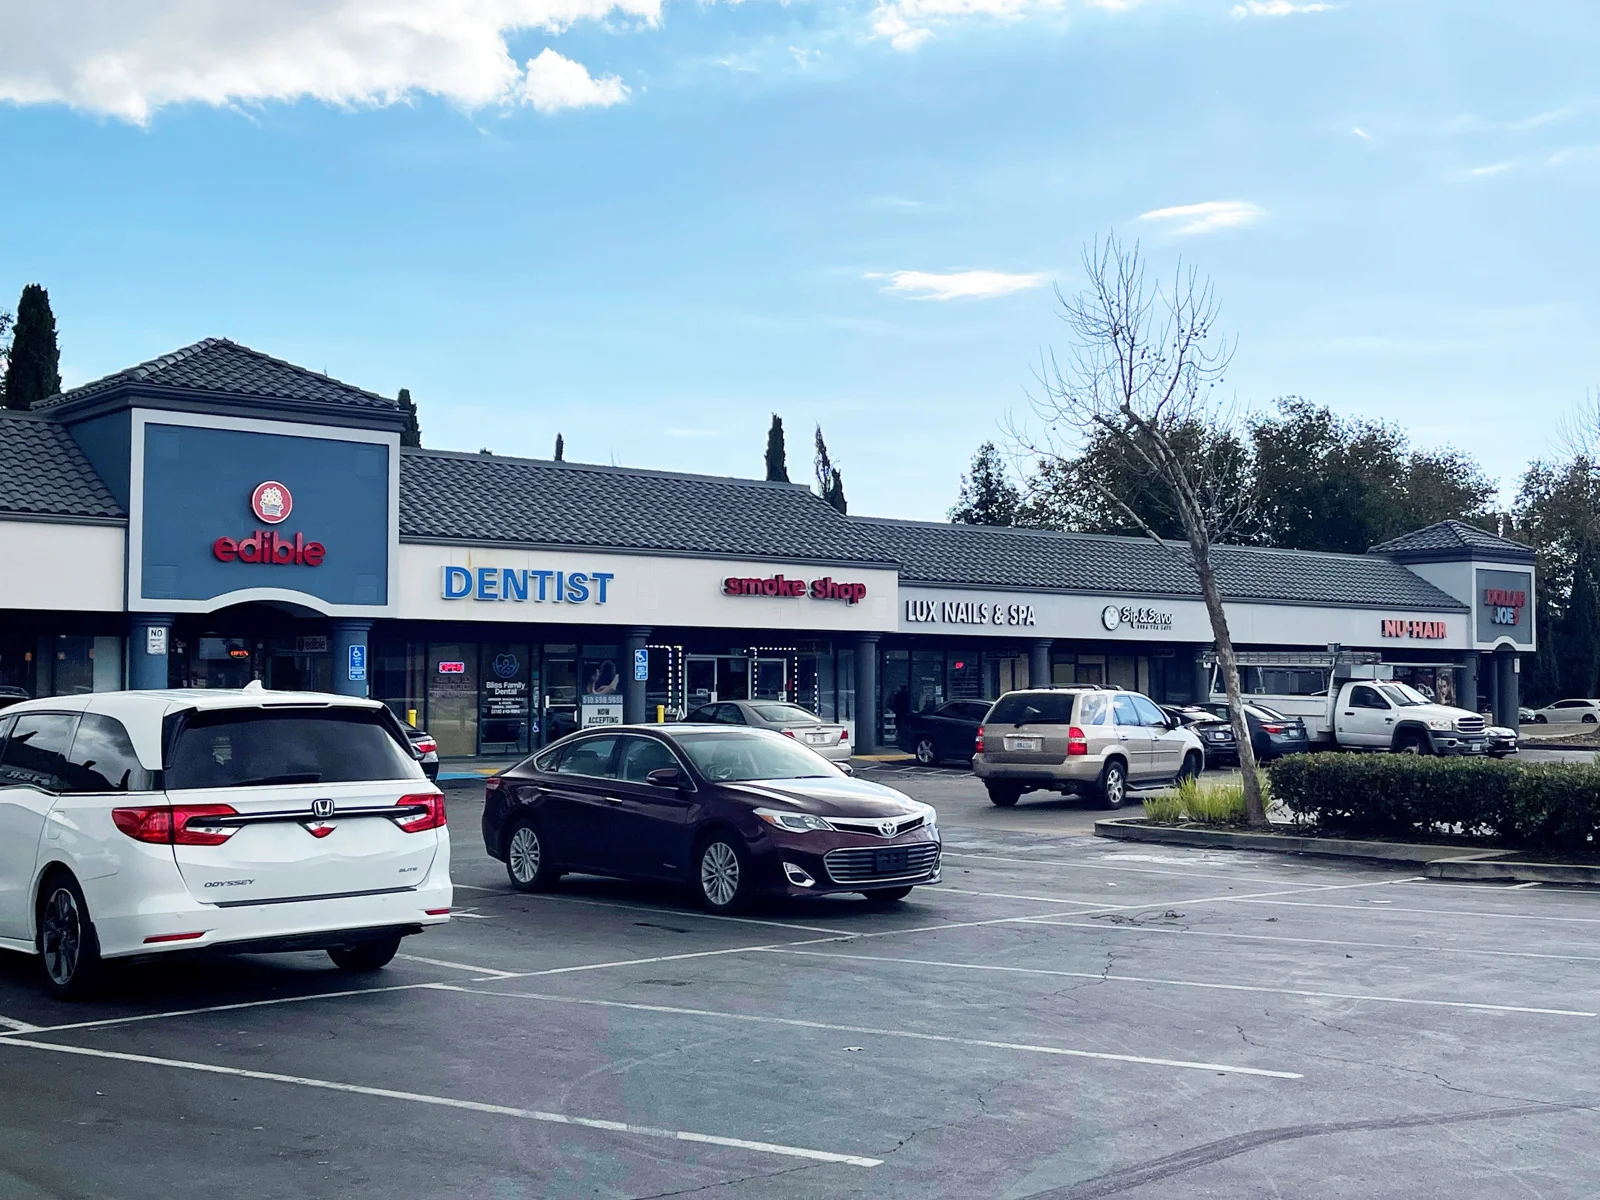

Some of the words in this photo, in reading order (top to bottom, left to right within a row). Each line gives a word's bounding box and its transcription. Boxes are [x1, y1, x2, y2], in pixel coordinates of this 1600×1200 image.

[213, 530, 326, 567] edible
[440, 565, 615, 605] DENTIST
[723, 574, 806, 597] smoke
[1484, 589, 1525, 607] DOLLAR
[905, 600, 938, 622] LUX
[941, 601, 989, 624] NAILS
[992, 604, 1004, 625] &
[1007, 604, 1036, 626] SPA
[1491, 606, 1520, 625] JOES
[150, 629, 163, 637] NO
[1381, 619, 1447, 639] NU-HAIR
[503, 681, 526, 690] Family
[587, 716, 619, 724] ACCEPTING
[597, 708, 610, 716] NOW
[203, 878, 256, 888] ODYSSEY
